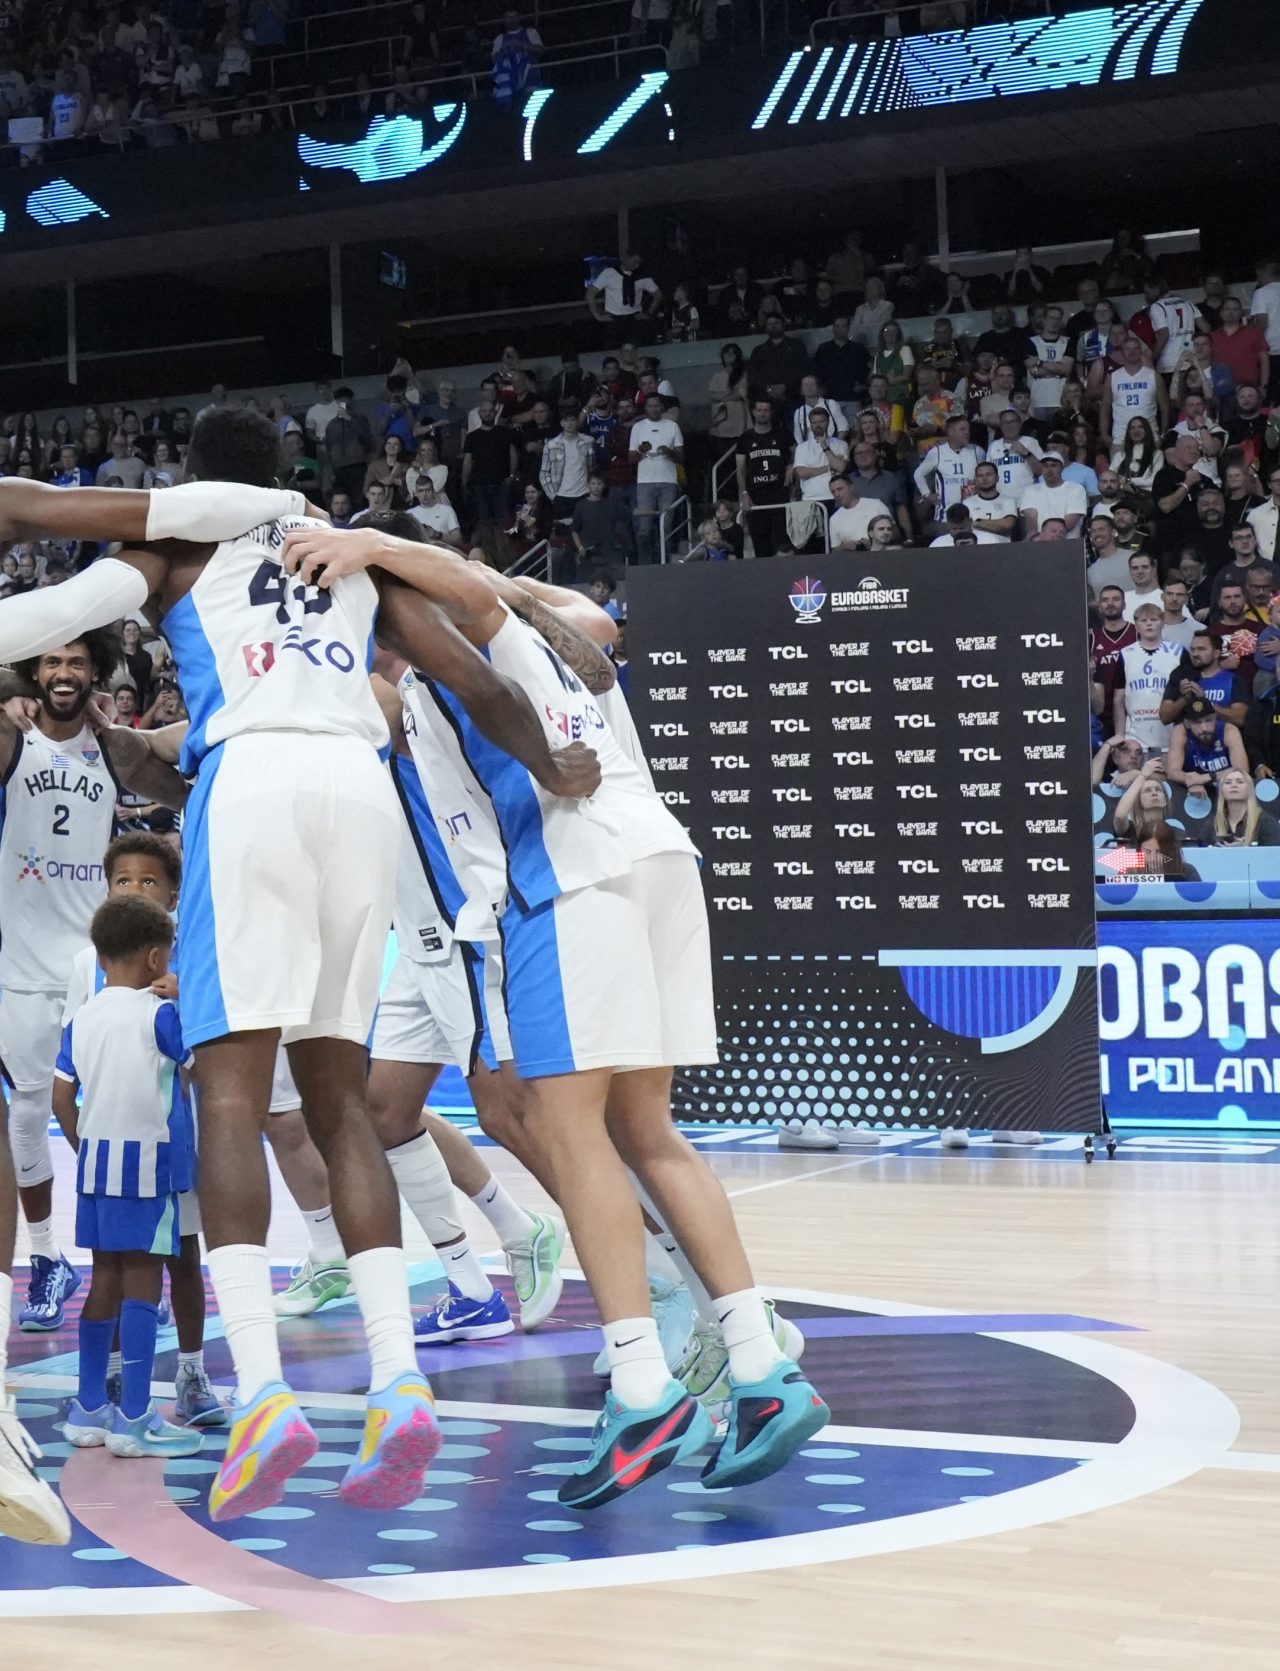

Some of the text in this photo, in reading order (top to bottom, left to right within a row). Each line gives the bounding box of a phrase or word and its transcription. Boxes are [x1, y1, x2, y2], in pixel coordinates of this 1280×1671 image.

[1117, 382, 1148, 390] FINLAND
[1127, 394, 1139, 406] 23
[831, 589, 909, 605] EUROBASKET
[830, 642, 857, 650] PLAYER
[892, 640, 933, 653] TCL
[956, 636, 984, 645] PLAYER
[1021, 633, 1063, 647] TCL
[649, 652, 687, 665] TCL
[708, 648, 734, 656] PLAYER
[768, 646, 808, 659] TCL
[1143, 660, 1153, 675] 6
[893, 677, 921, 685] PLAYER
[957, 674, 999, 688] TCL
[1022, 671, 1051, 679] PLAYER
[649, 687, 675, 695] PLAYER
[709, 685, 748, 698] TCL
[769, 682, 796, 690] PLAYER
[831, 680, 871, 693] TCL
[832, 716, 860, 724] PLAYER
[895, 714, 935, 728] TCL
[958, 712, 986, 720] PLAYER
[1023, 709, 1065, 723] TCL
[650, 723, 689, 736] TCL
[771, 719, 810, 732] TCL
[833, 752, 873, 765] TCL
[959, 748, 1001, 761] TCL
[711, 756, 750, 769] TCL
[24, 769, 104, 803] HELLAS
[896, 785, 937, 798] TCL
[1025, 781, 1067, 795] TCL
[772, 788, 812, 801] TCL
[52, 804, 70, 836] 2
[897, 822, 925, 830] PLAYER
[1026, 819, 1055, 827] PLAYER
[712, 826, 751, 839] TCL
[835, 824, 875, 837] TCL
[961, 821, 1003, 835] TCL
[774, 862, 813, 875] TCL
[898, 860, 939, 873] TCL
[1027, 858, 1070, 871] TCL
[1123, 875, 1163, 883] TISSOT
[714, 897, 753, 911] TCL
[836, 896, 876, 909] TCL
[899, 895, 927, 903] PLAYER
[963, 895, 1005, 908] TCL
[1097, 944, 1280, 1041] OBA
[1128, 1057, 1280, 1093] POLAN
